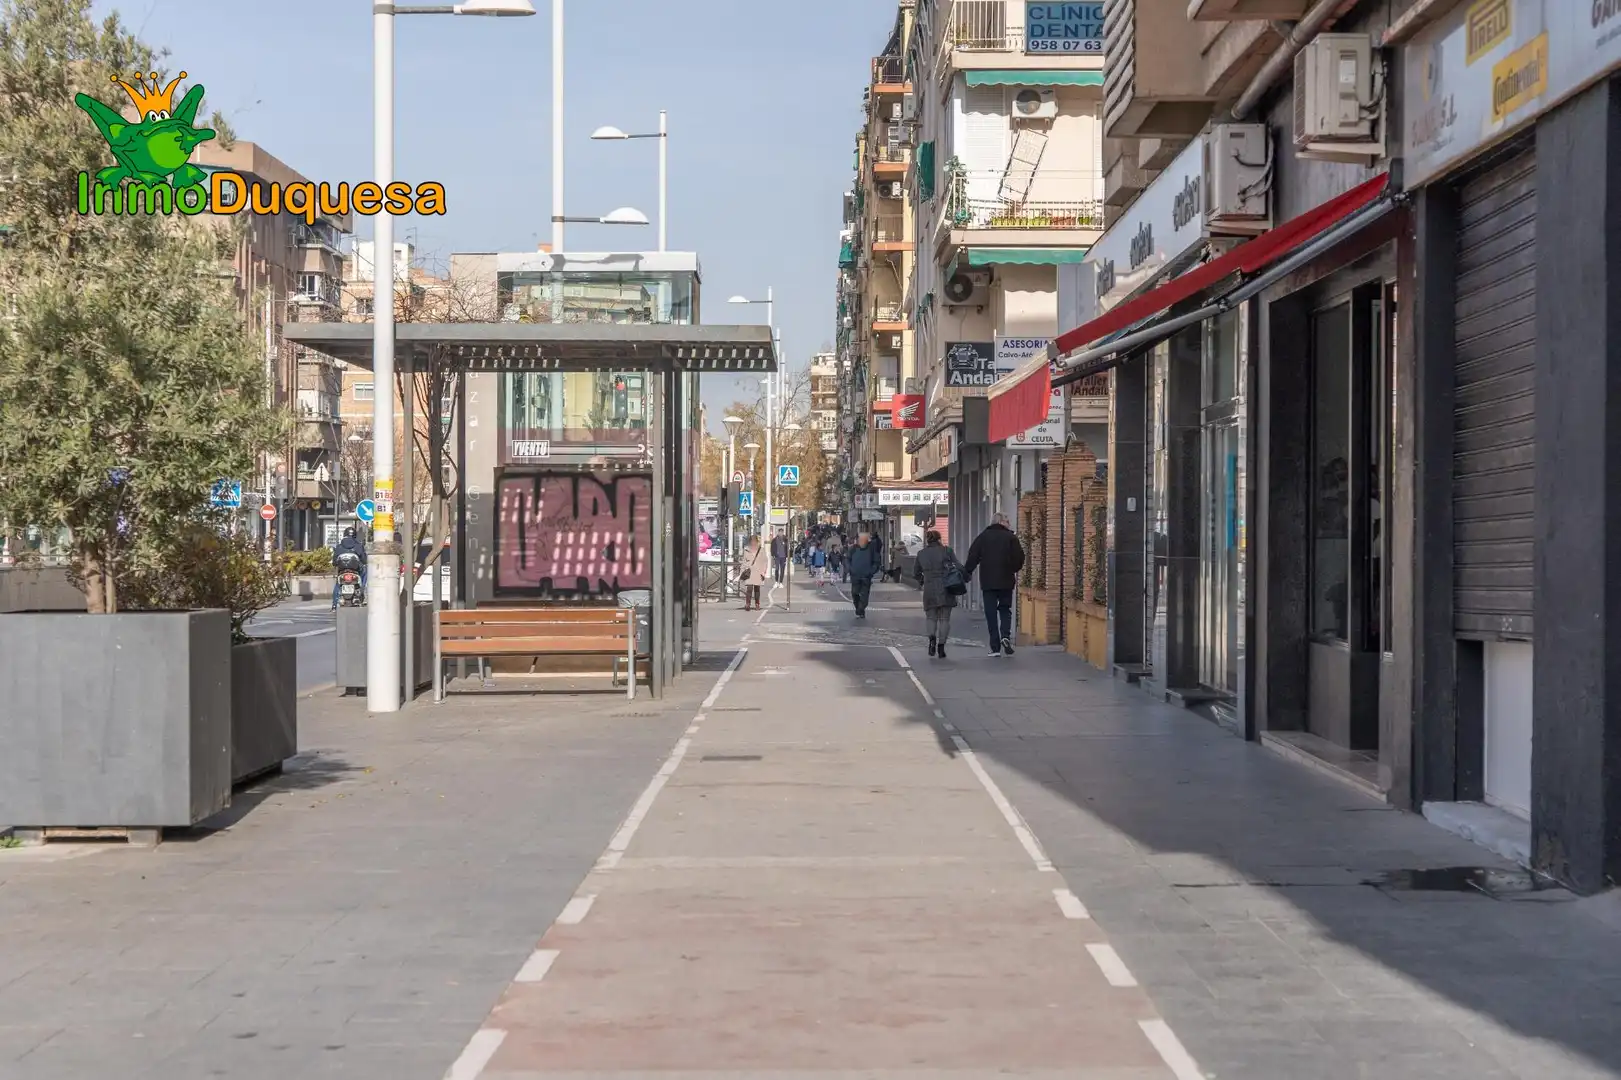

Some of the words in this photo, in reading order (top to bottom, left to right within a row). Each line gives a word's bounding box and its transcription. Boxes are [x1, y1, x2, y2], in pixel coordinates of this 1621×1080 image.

[1031, 40, 1058, 50] 958
[1062, 41, 1080, 50] 07
[1084, 41, 1102, 50] 63
[1031, 435, 1054, 443] CEUTA
